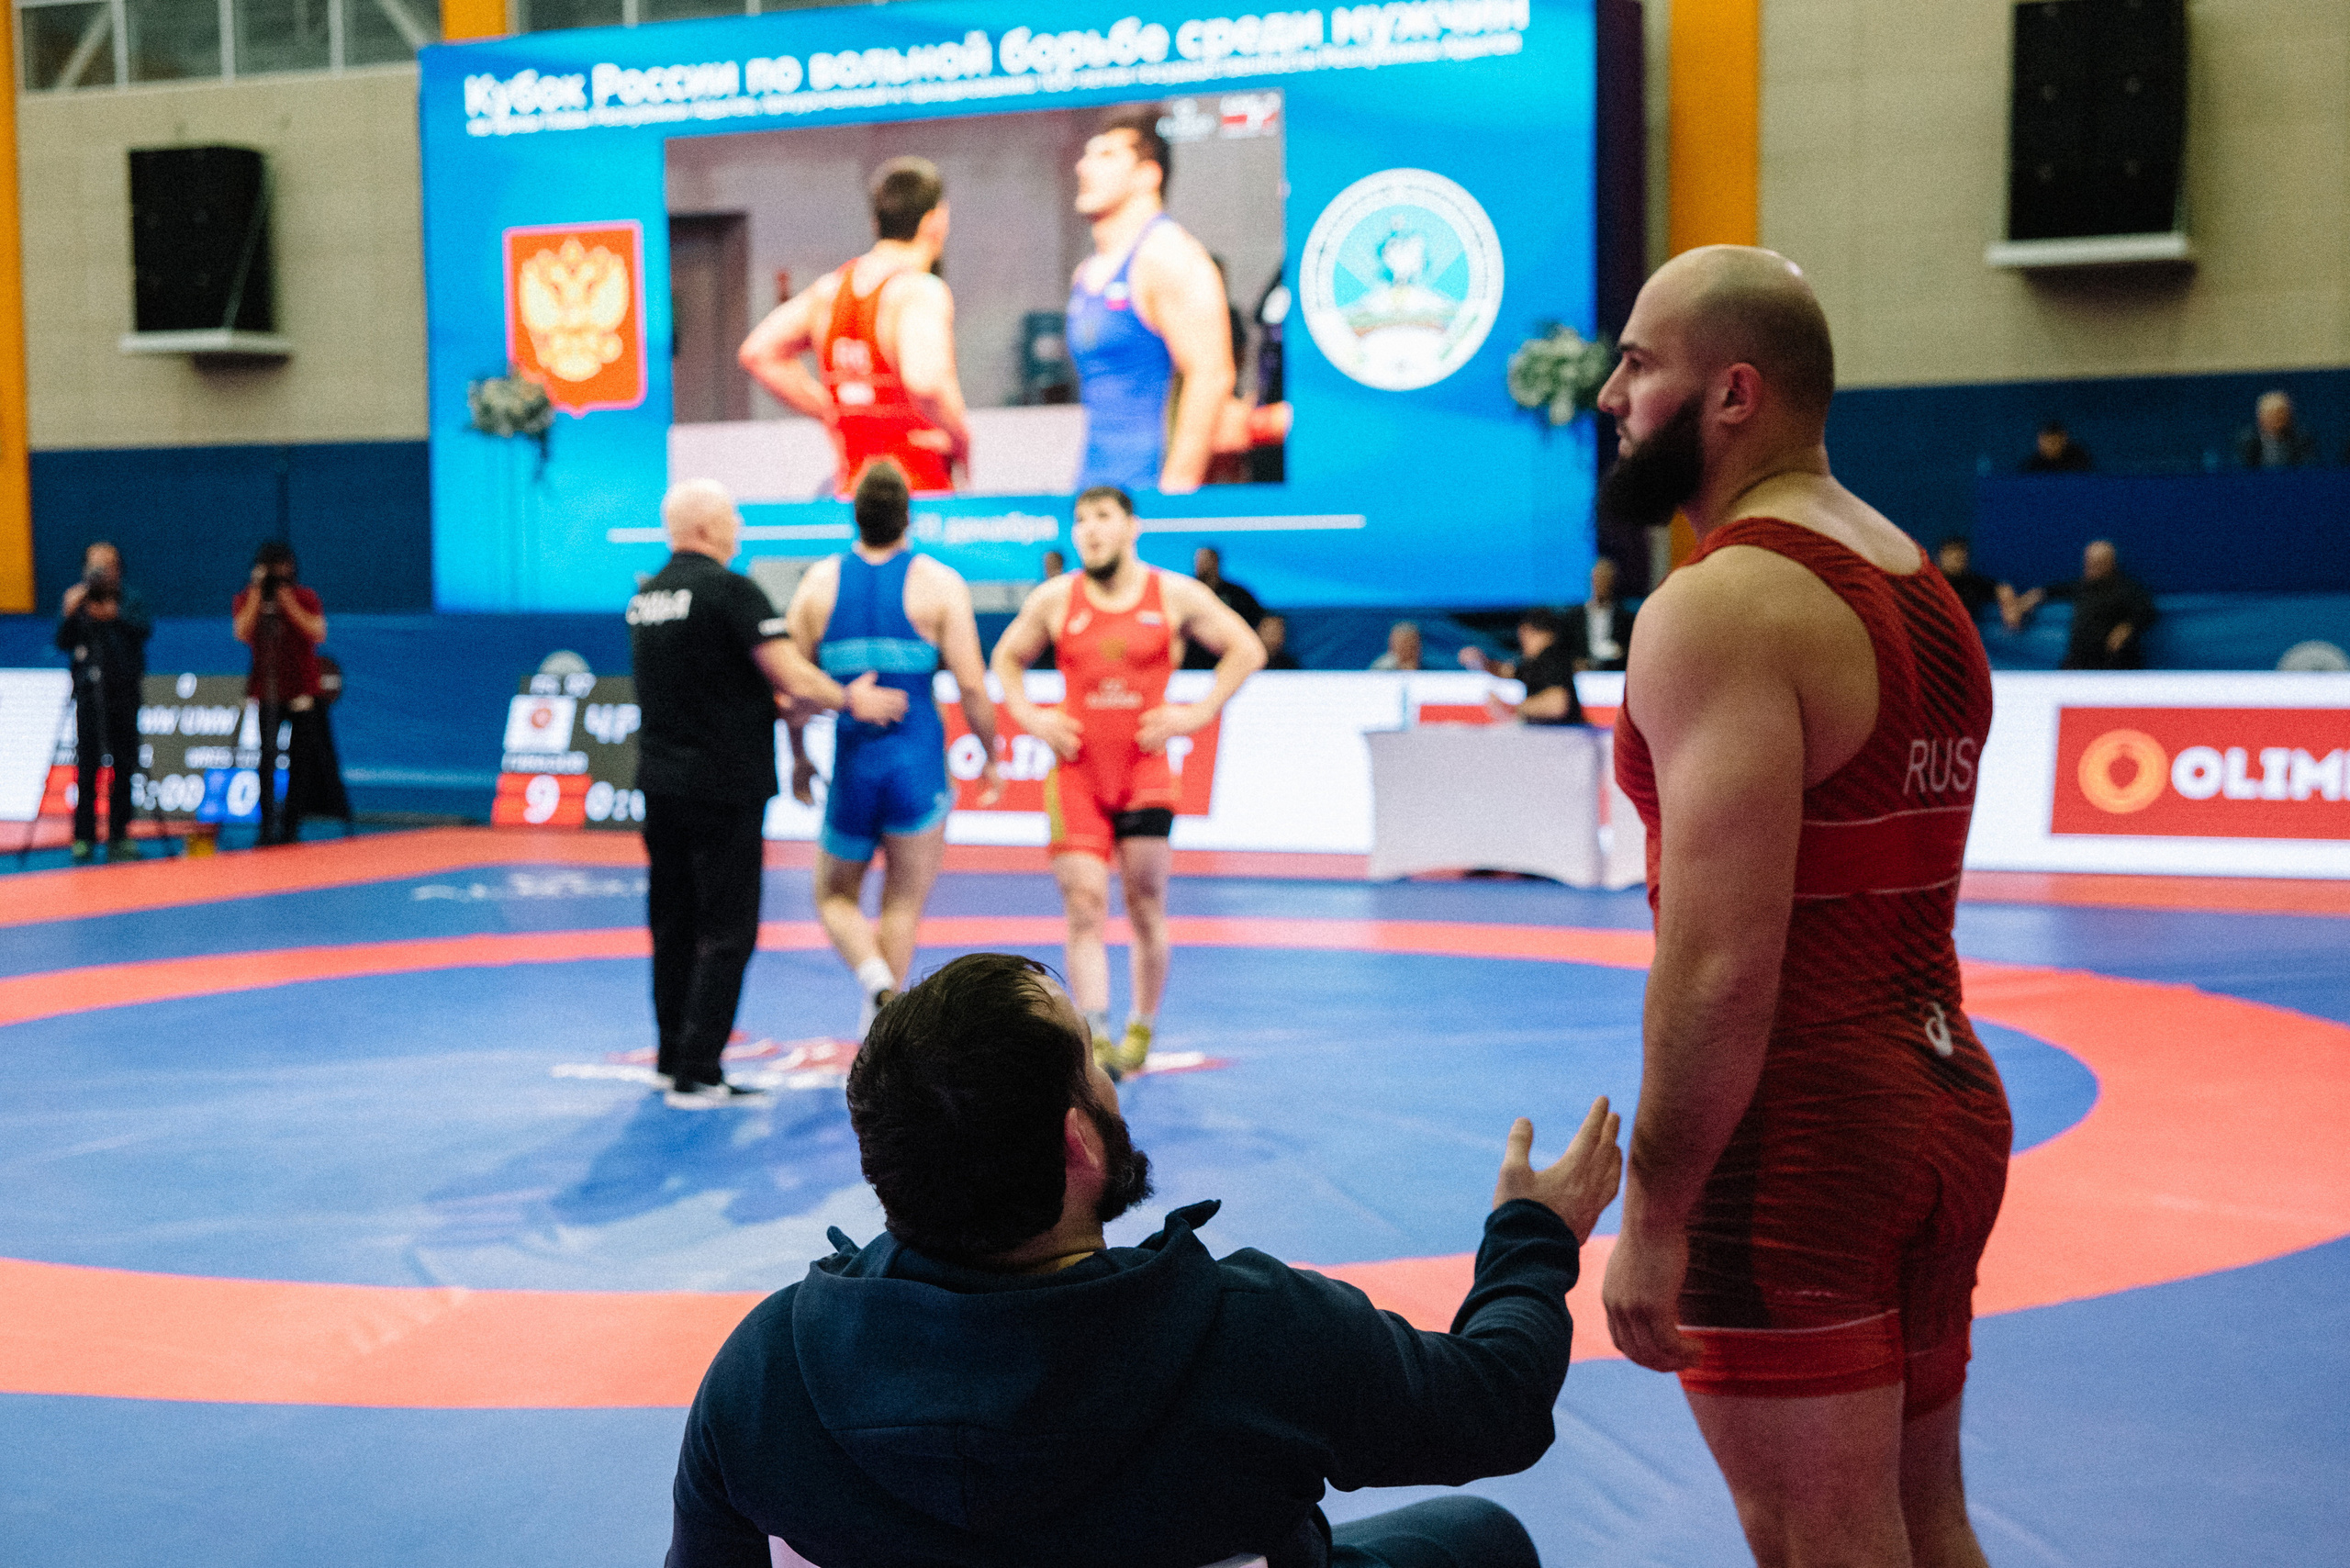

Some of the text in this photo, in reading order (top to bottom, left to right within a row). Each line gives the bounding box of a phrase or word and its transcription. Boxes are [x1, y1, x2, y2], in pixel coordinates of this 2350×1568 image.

[464, 69, 587, 120] Кубок
[592, 61, 739, 106] России
[745, 55, 803, 95] по
[809, 29, 992, 90] вольной
[999, 16, 1170, 84] борьбе
[1176, 10, 1324, 66] среди
[1331, 0, 1530, 53] мужчин
[1903, 736, 1976, 795] RUS
[2170, 745, 2350, 801] OLIM
[523, 774, 561, 824] 9
